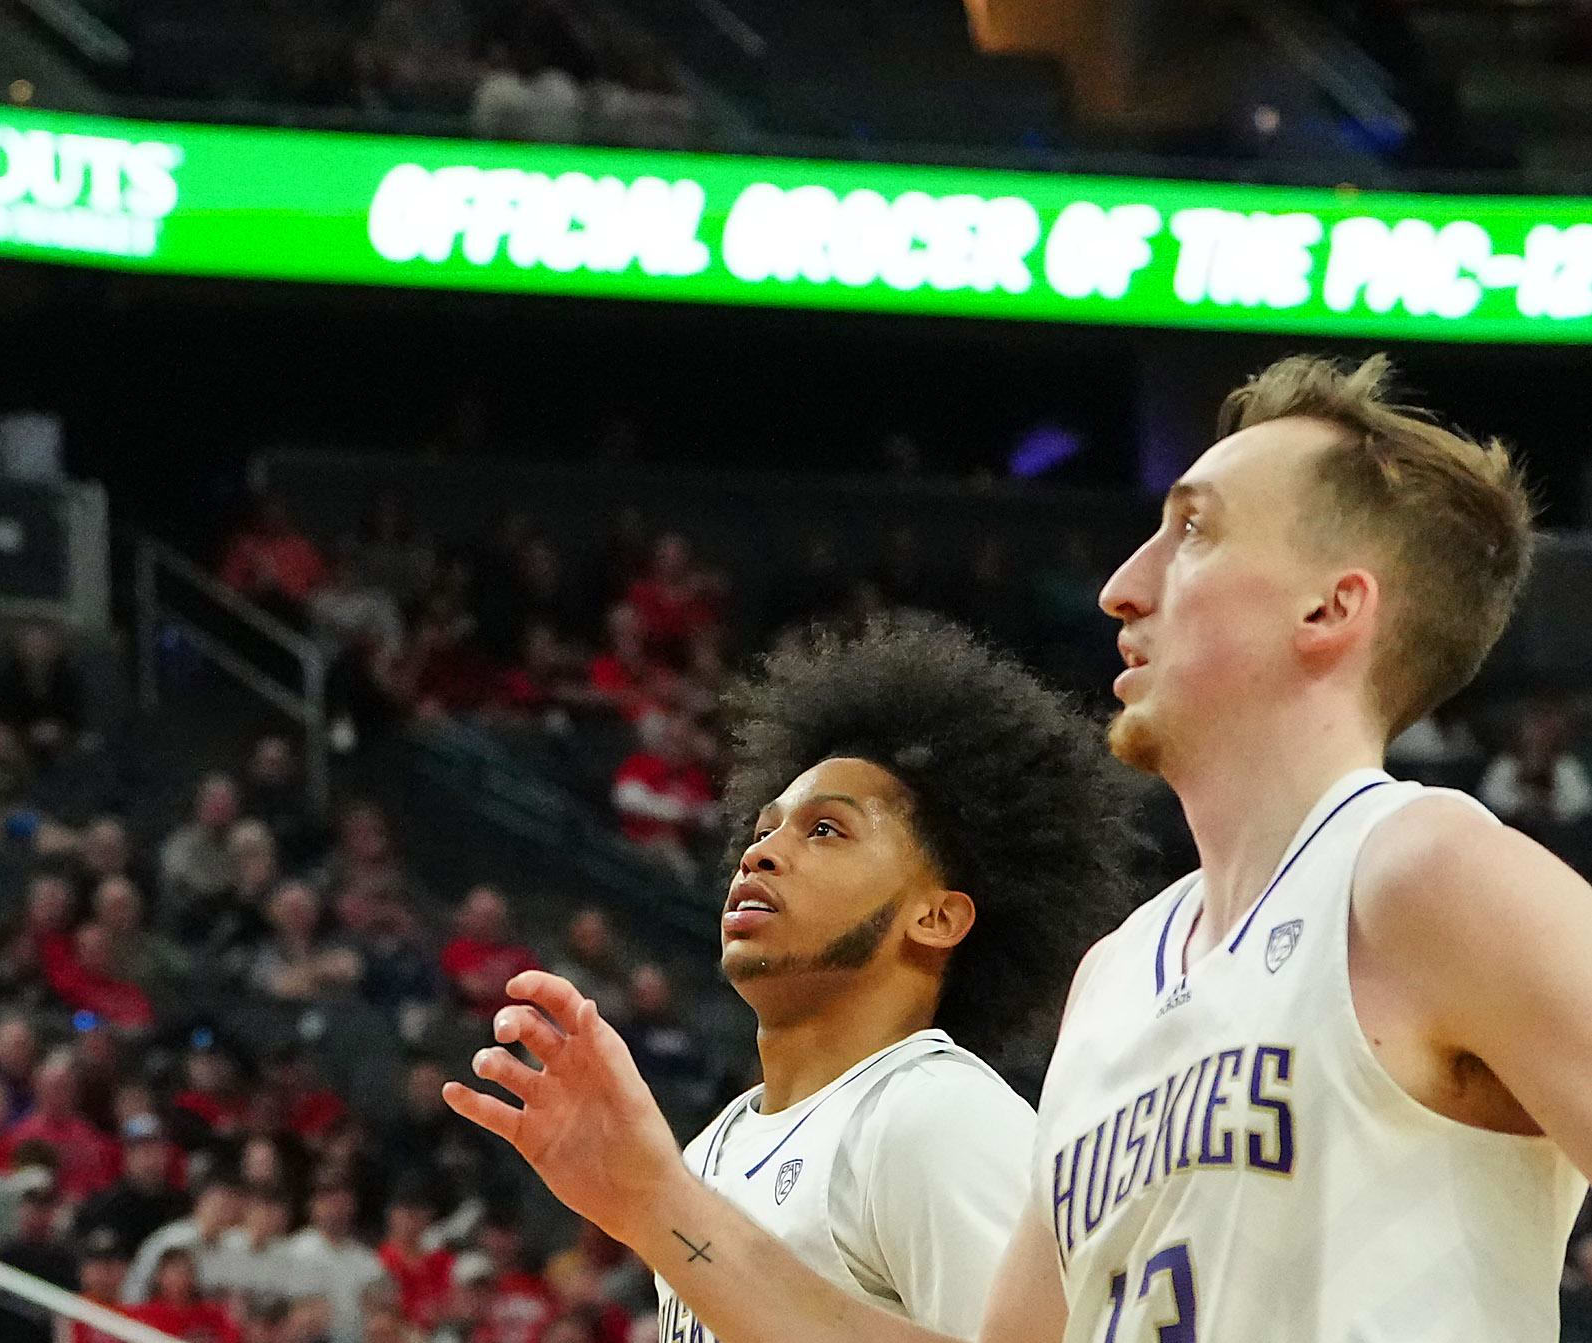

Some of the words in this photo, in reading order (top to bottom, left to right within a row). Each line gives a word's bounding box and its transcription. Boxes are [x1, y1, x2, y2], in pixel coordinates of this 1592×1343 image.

[368, 163, 711, 277] OFFICIAL
[722, 182, 1041, 294] GROCER
[1044, 200, 1163, 299] OF
[1170, 207, 1323, 309] THE
[1053, 1044, 1296, 1273] HUSKIES
